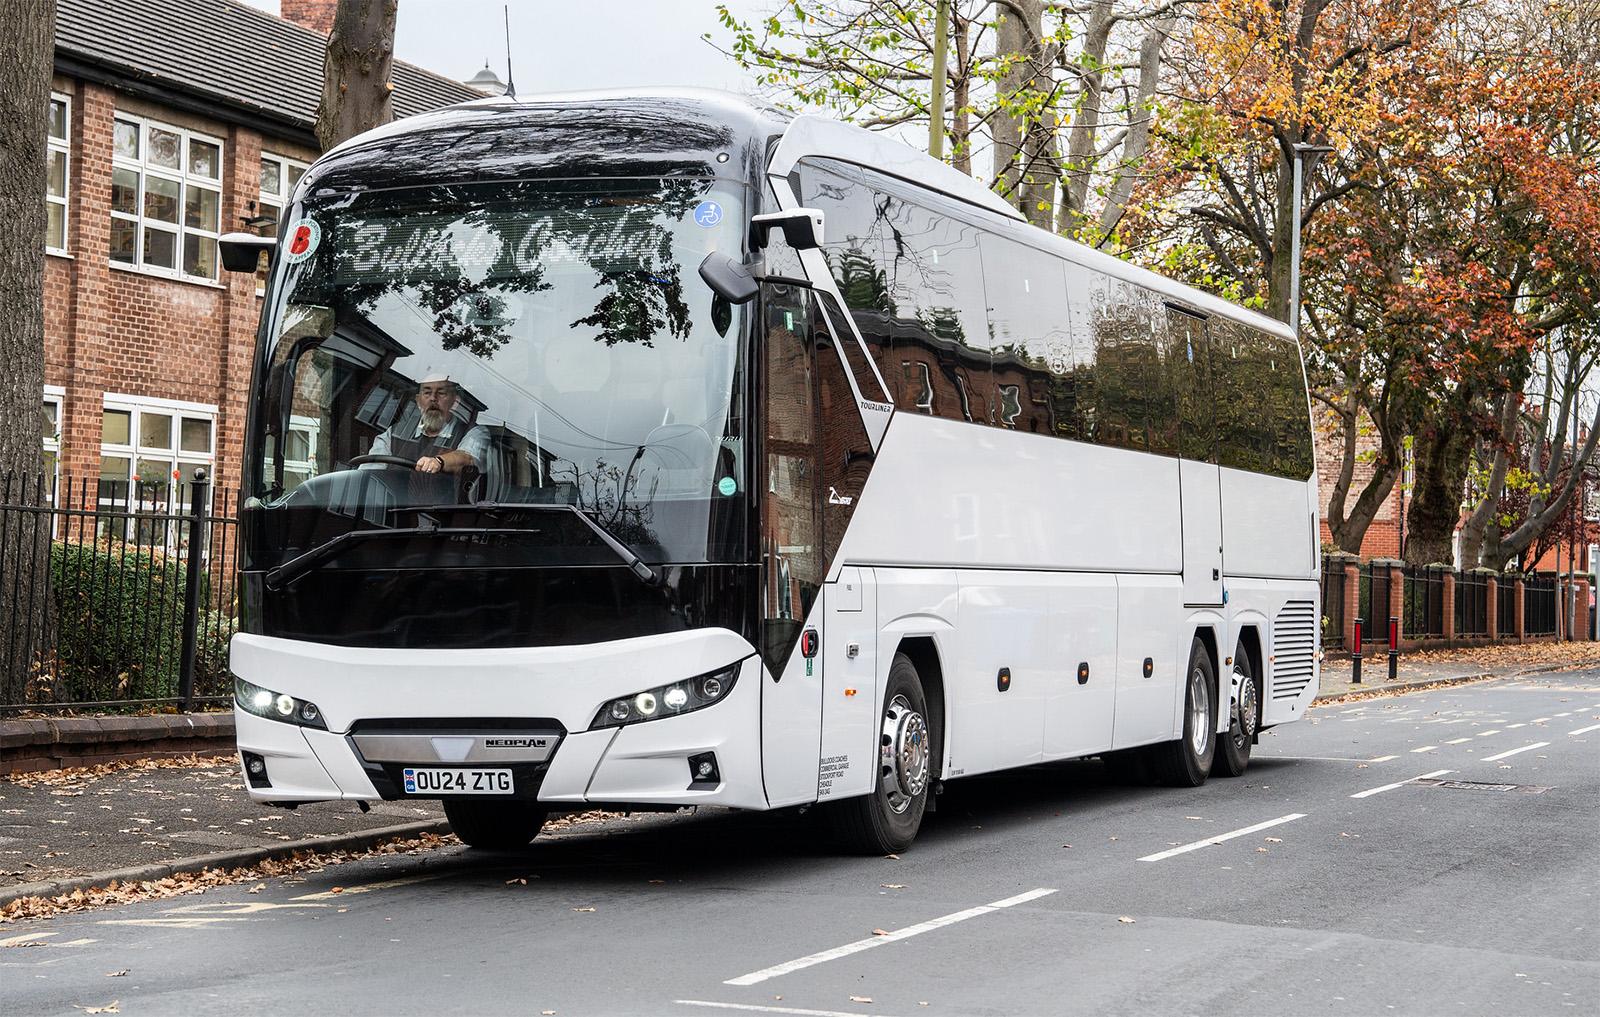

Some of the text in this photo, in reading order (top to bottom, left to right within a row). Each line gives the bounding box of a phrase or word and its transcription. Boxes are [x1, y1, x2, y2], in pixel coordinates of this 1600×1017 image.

[861, 401, 891, 412] TOURLINER
[485, 739, 546, 747] NEOPLAN
[417, 771, 510, 790] OU24 ZTG
